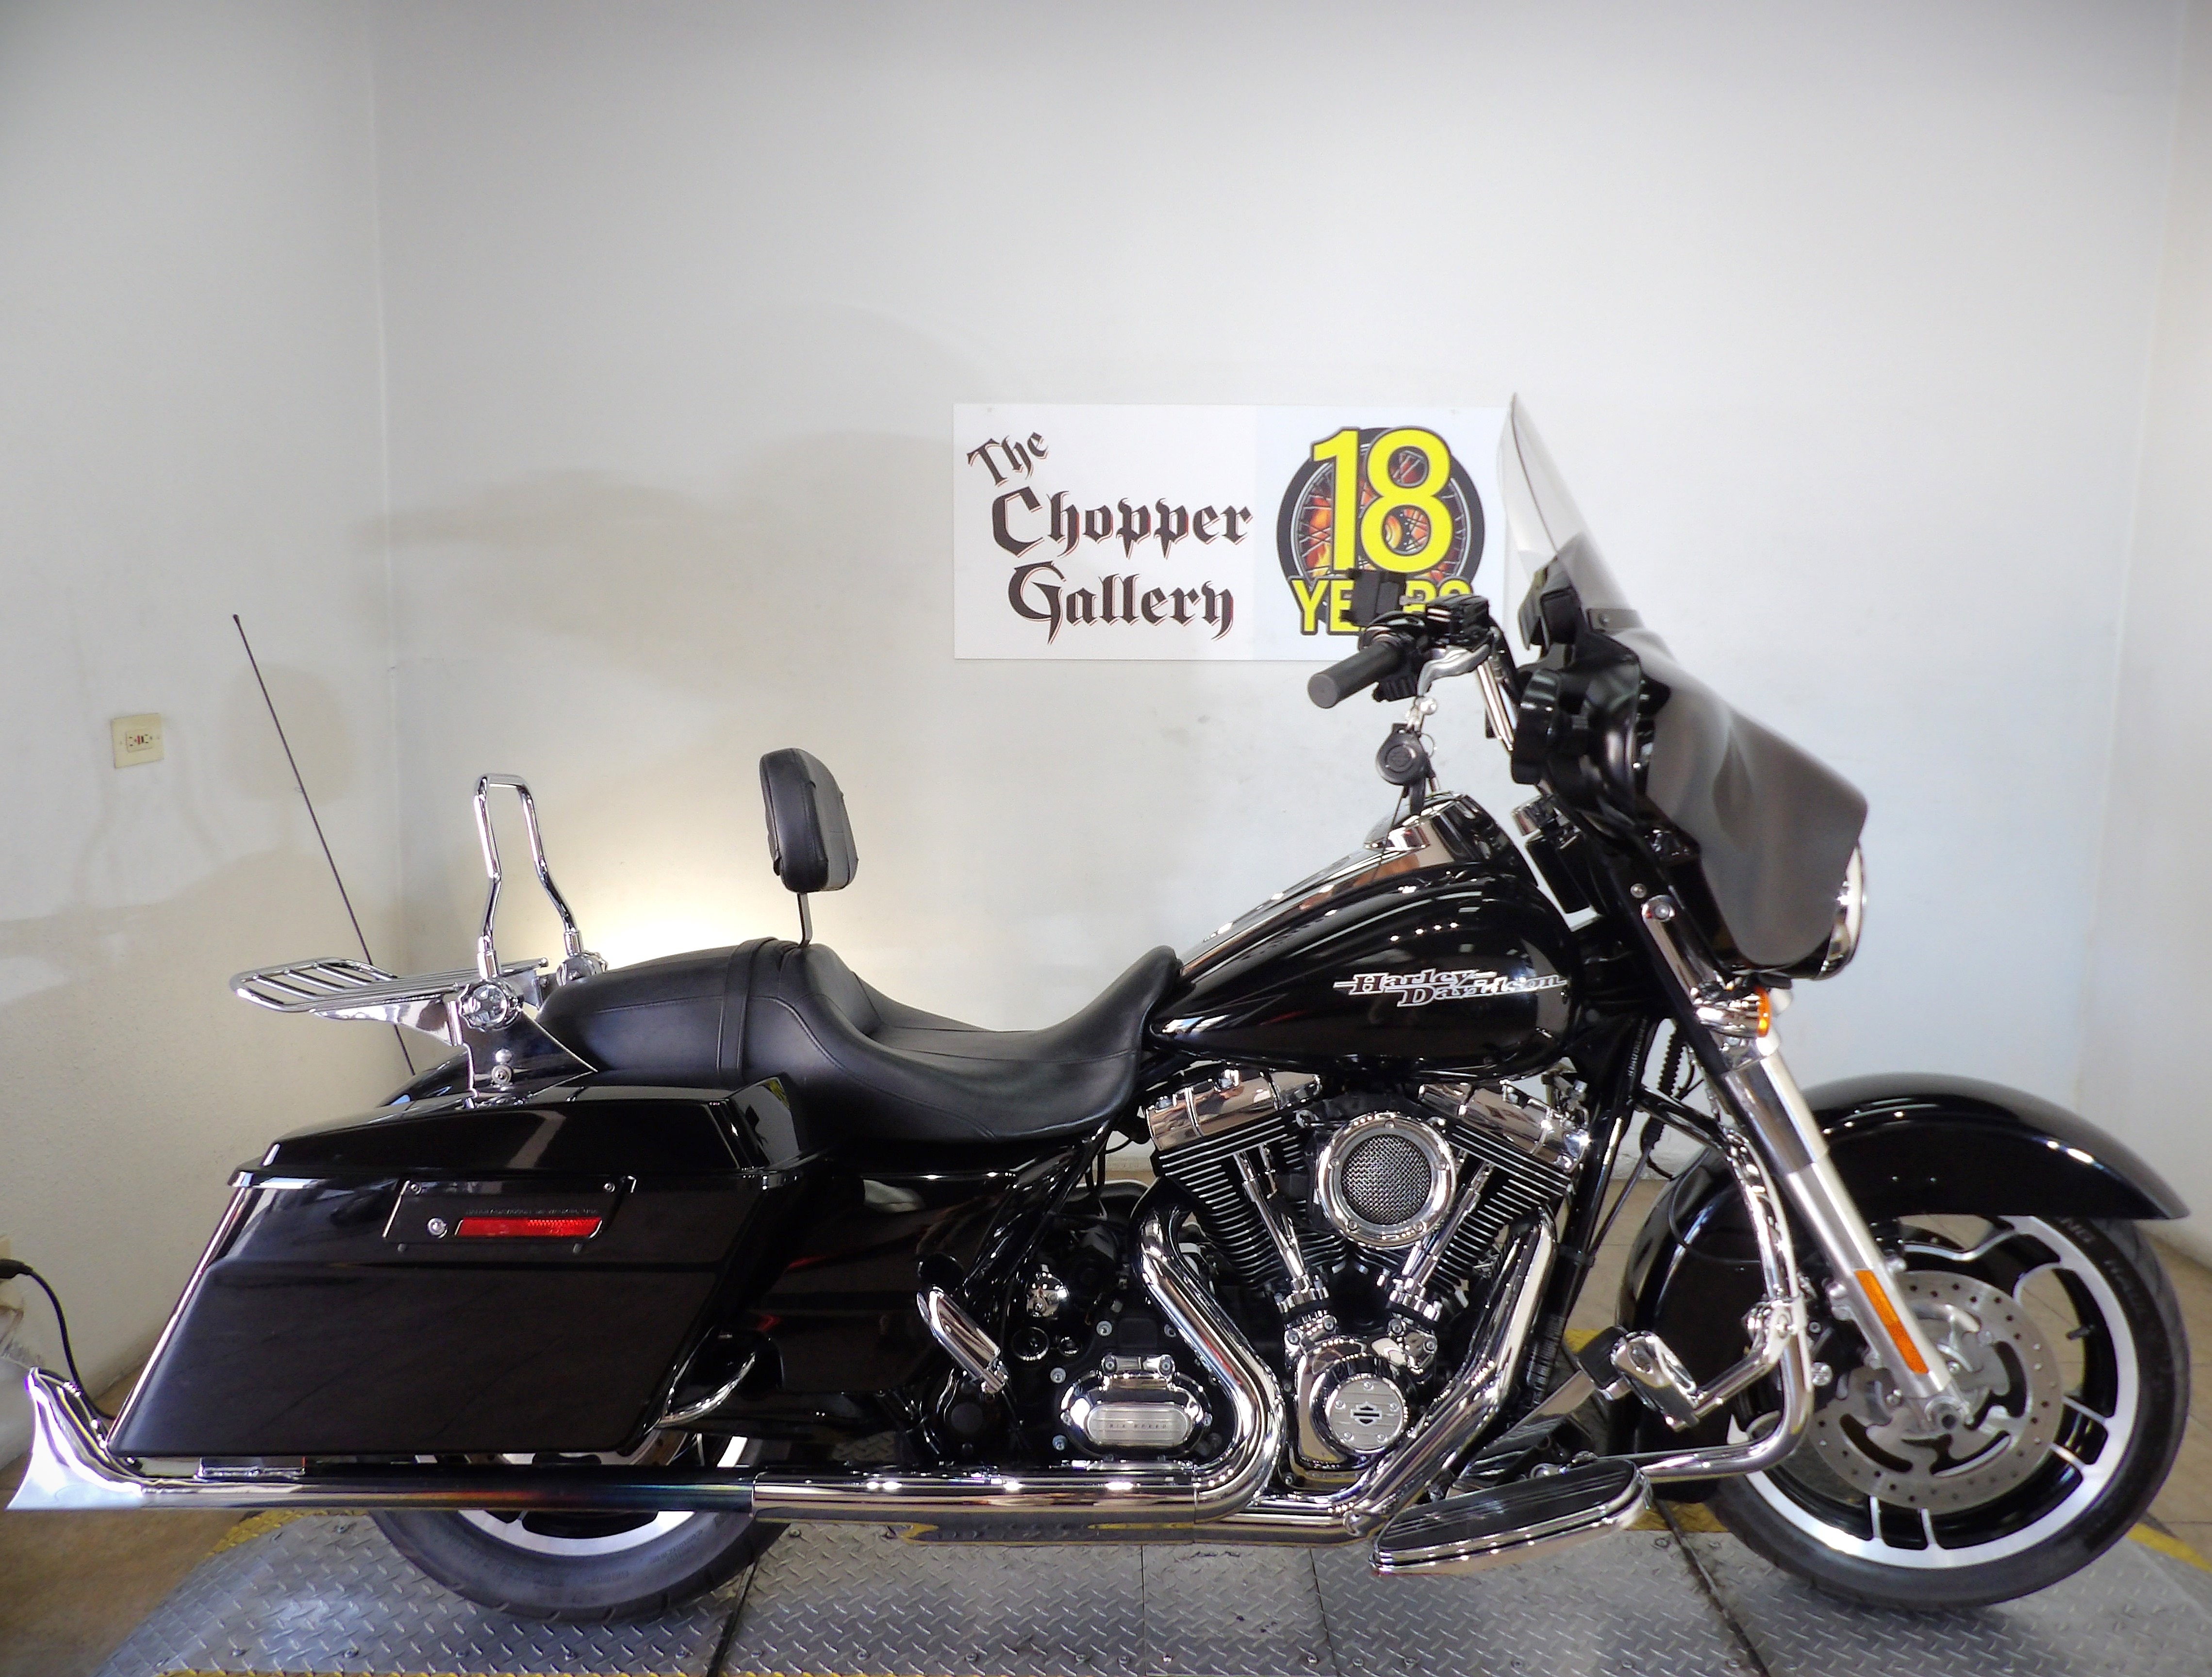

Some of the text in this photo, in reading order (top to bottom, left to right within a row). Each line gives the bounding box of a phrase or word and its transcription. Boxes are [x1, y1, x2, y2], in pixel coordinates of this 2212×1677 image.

[967, 432, 1048, 486] The
[992, 486, 1253, 559] Chopper
[1310, 427, 1452, 573] 18
[1008, 561, 1234, 644] Gallery
[1386, 974, 1567, 1007] Davidson
